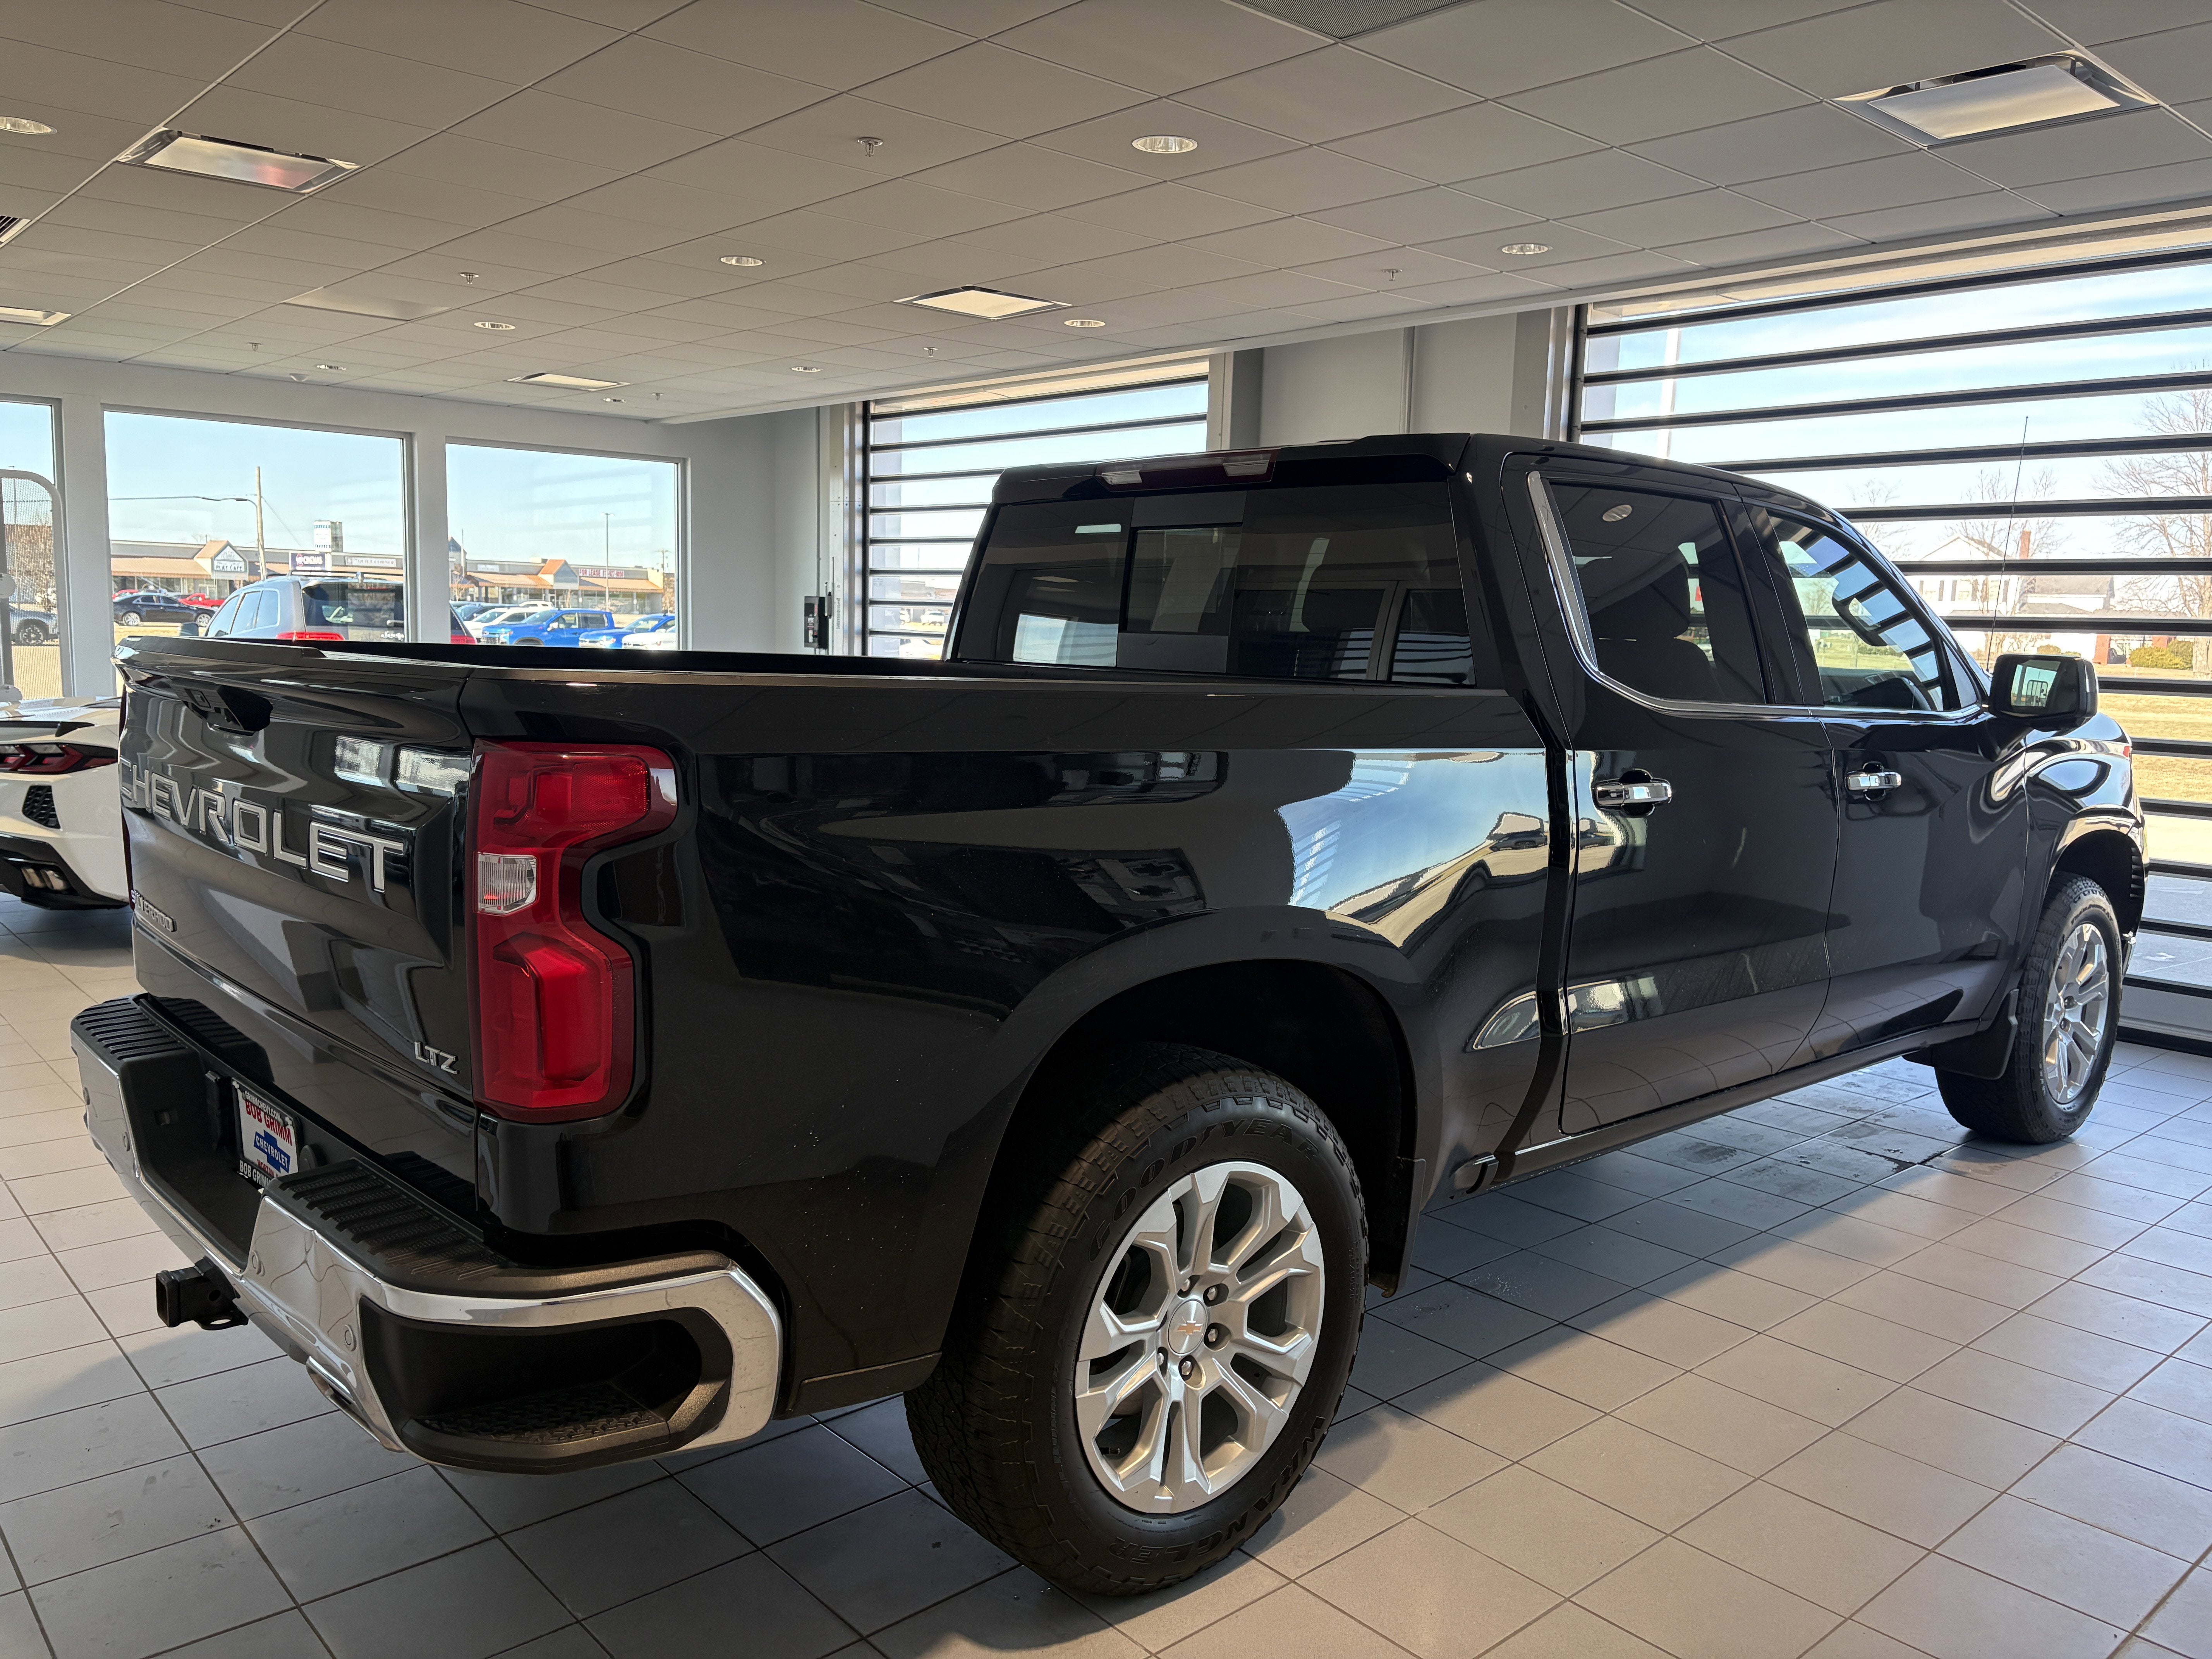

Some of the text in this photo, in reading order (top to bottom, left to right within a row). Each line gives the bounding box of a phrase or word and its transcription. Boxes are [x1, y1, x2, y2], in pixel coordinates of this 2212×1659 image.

[119, 755, 404, 893] CHEVROLET
[131, 889, 173, 932] SILVERADO
[414, 1041, 458, 1075] LTZ
[245, 1100, 292, 1146] BOB GRIMM
[239, 1160, 251, 1178] BOB
[255, 1135, 289, 1168] CHEVROLET
[1089, 1118, 1319, 1262] GOODYEAR
[1108, 1415, 1326, 1564] WRANGLER
